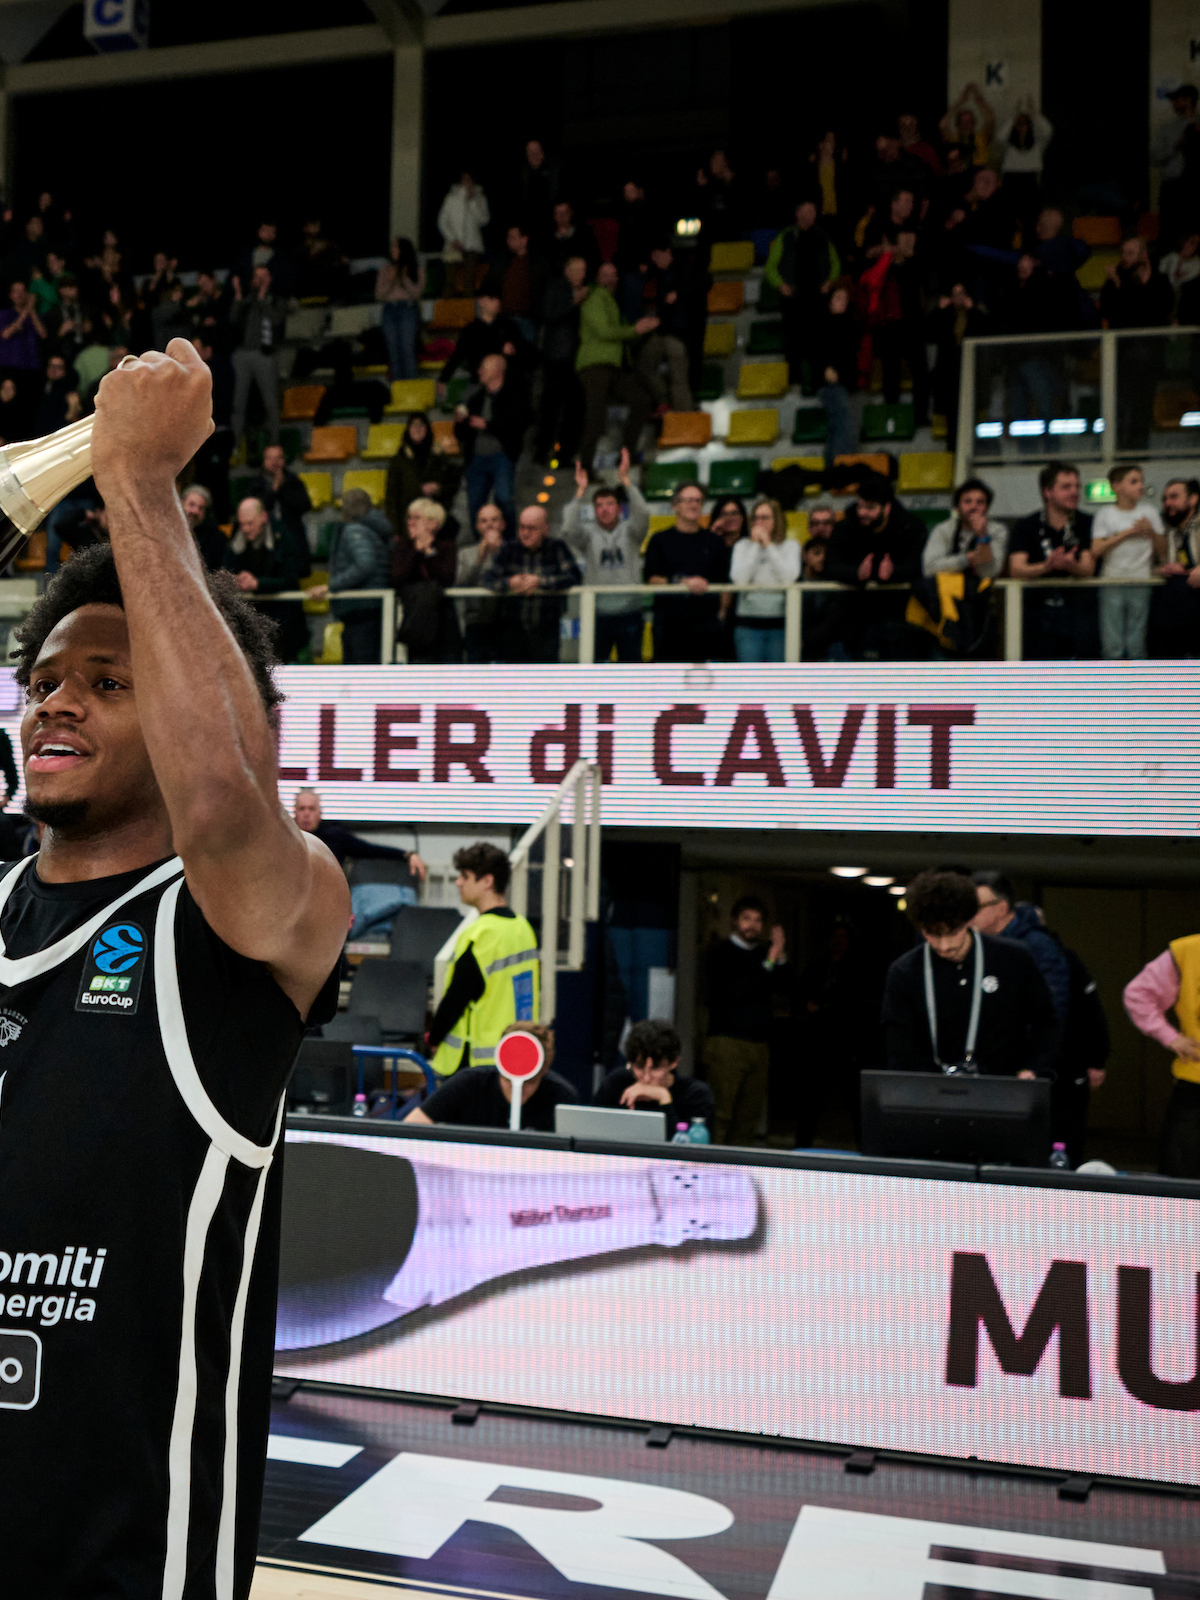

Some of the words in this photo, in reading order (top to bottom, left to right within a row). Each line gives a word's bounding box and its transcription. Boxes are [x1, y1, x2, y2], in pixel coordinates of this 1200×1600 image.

[93, 0, 123, 25] C
[986, 62, 1003, 86] K
[277, 703, 494, 783] LER
[529, 703, 614, 785] di
[654, 703, 977, 789] CAVIT
[91, 976, 130, 990] BKT
[81, 992, 133, 1009] EuroCup
[946, 1250, 1200, 1413] MU
